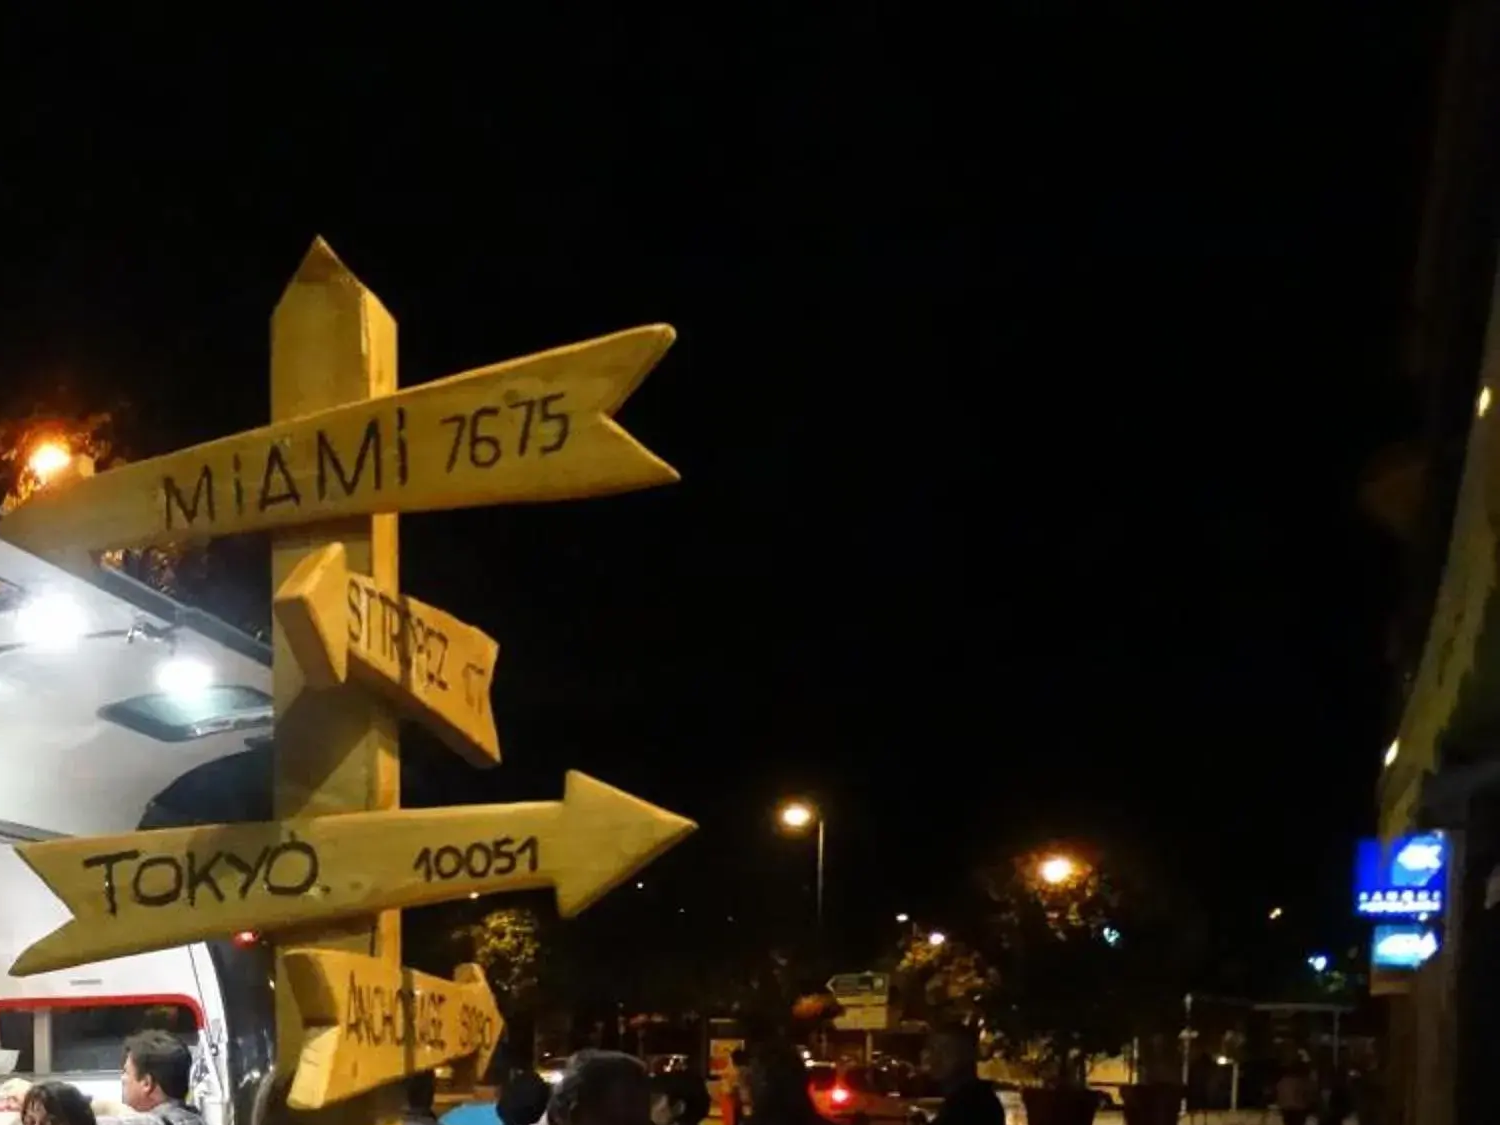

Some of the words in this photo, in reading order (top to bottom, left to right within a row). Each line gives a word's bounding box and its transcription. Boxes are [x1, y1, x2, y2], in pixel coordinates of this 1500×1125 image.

[439, 391, 571, 473] 7675
[83, 838, 321, 914] TOKYO
[413, 836, 540, 882] 10051
